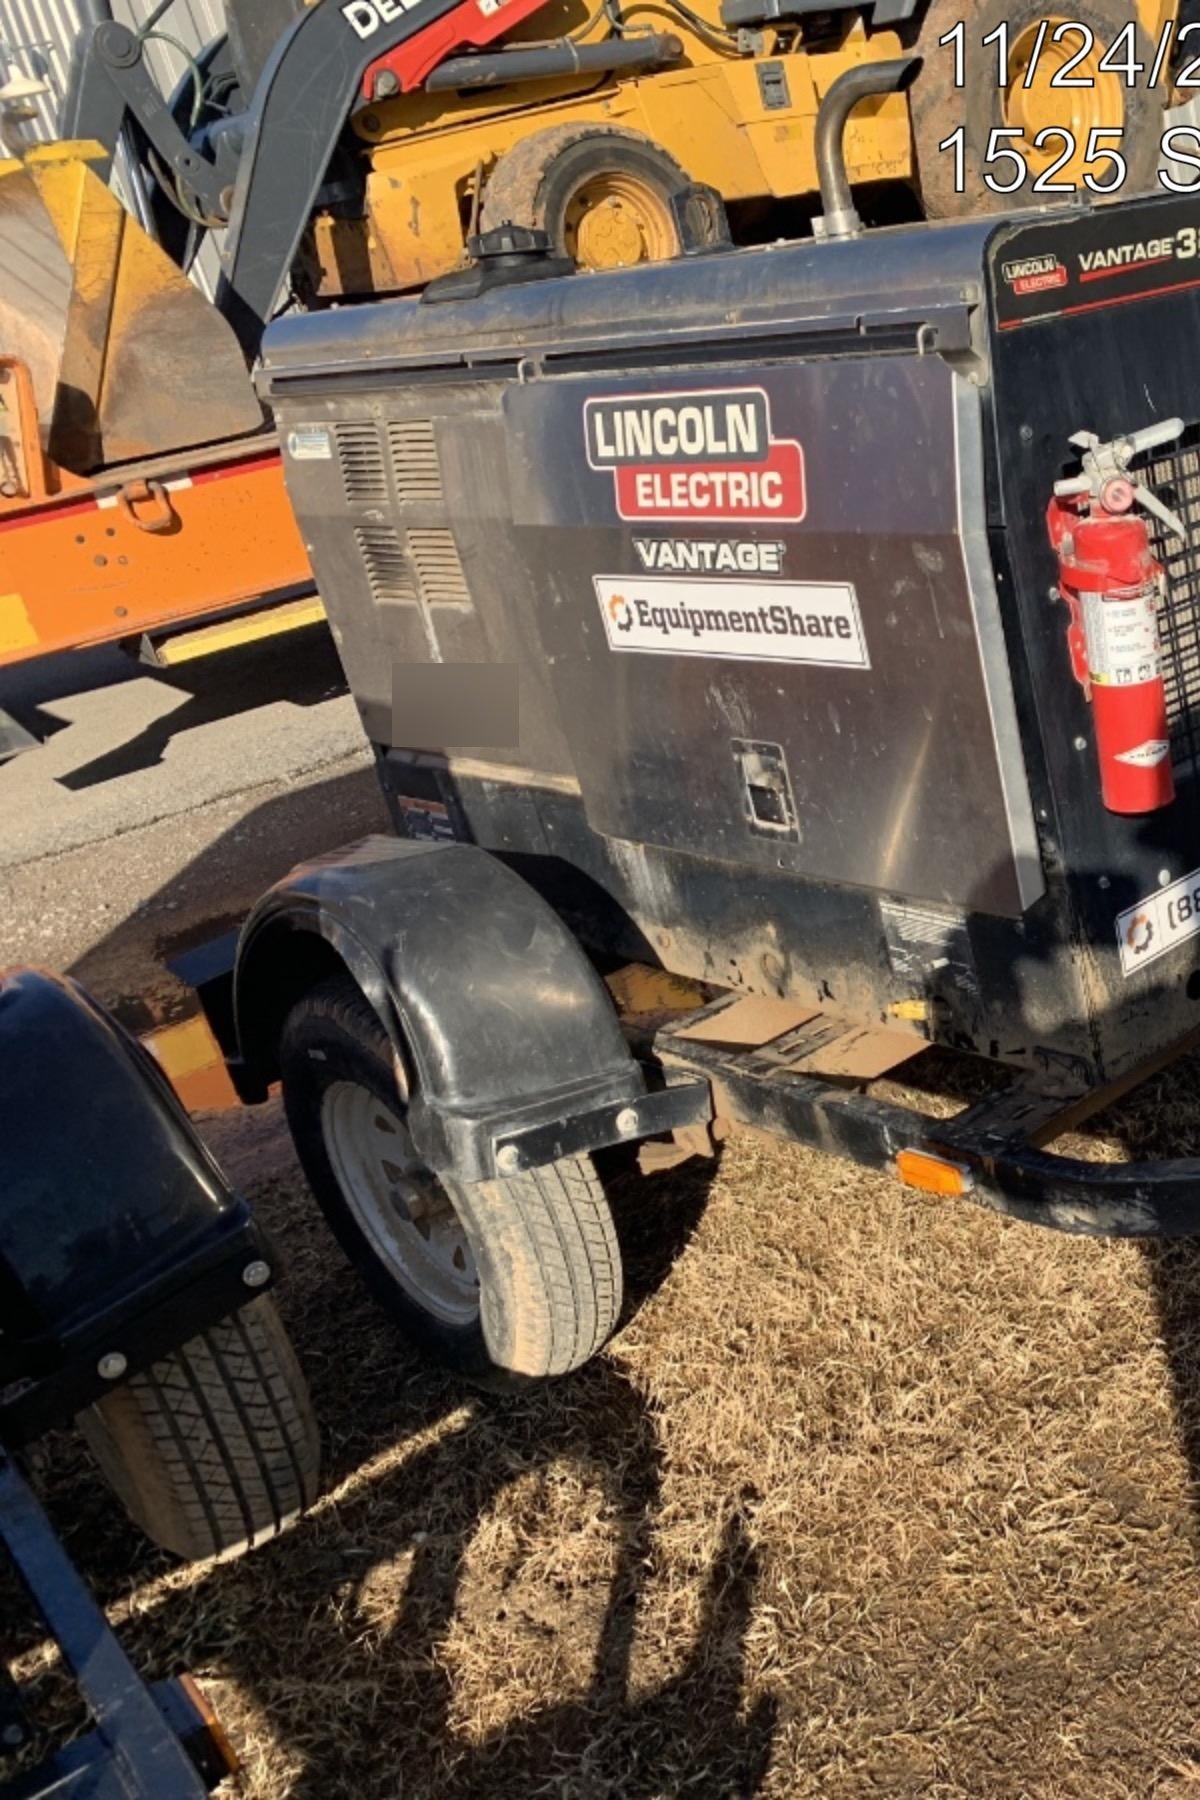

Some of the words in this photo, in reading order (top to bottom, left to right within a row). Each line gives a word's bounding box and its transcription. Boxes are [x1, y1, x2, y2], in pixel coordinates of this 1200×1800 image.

[1005, 257, 1054, 279] LINCOLN
[1078, 236, 1175, 271] VANTAGE
[594, 403, 759, 457] LINCOLN
[635, 471, 783, 509] ELECTRIC
[635, 540, 781, 571] VANTAGE
[633, 599, 852, 639] EquipmentShare
